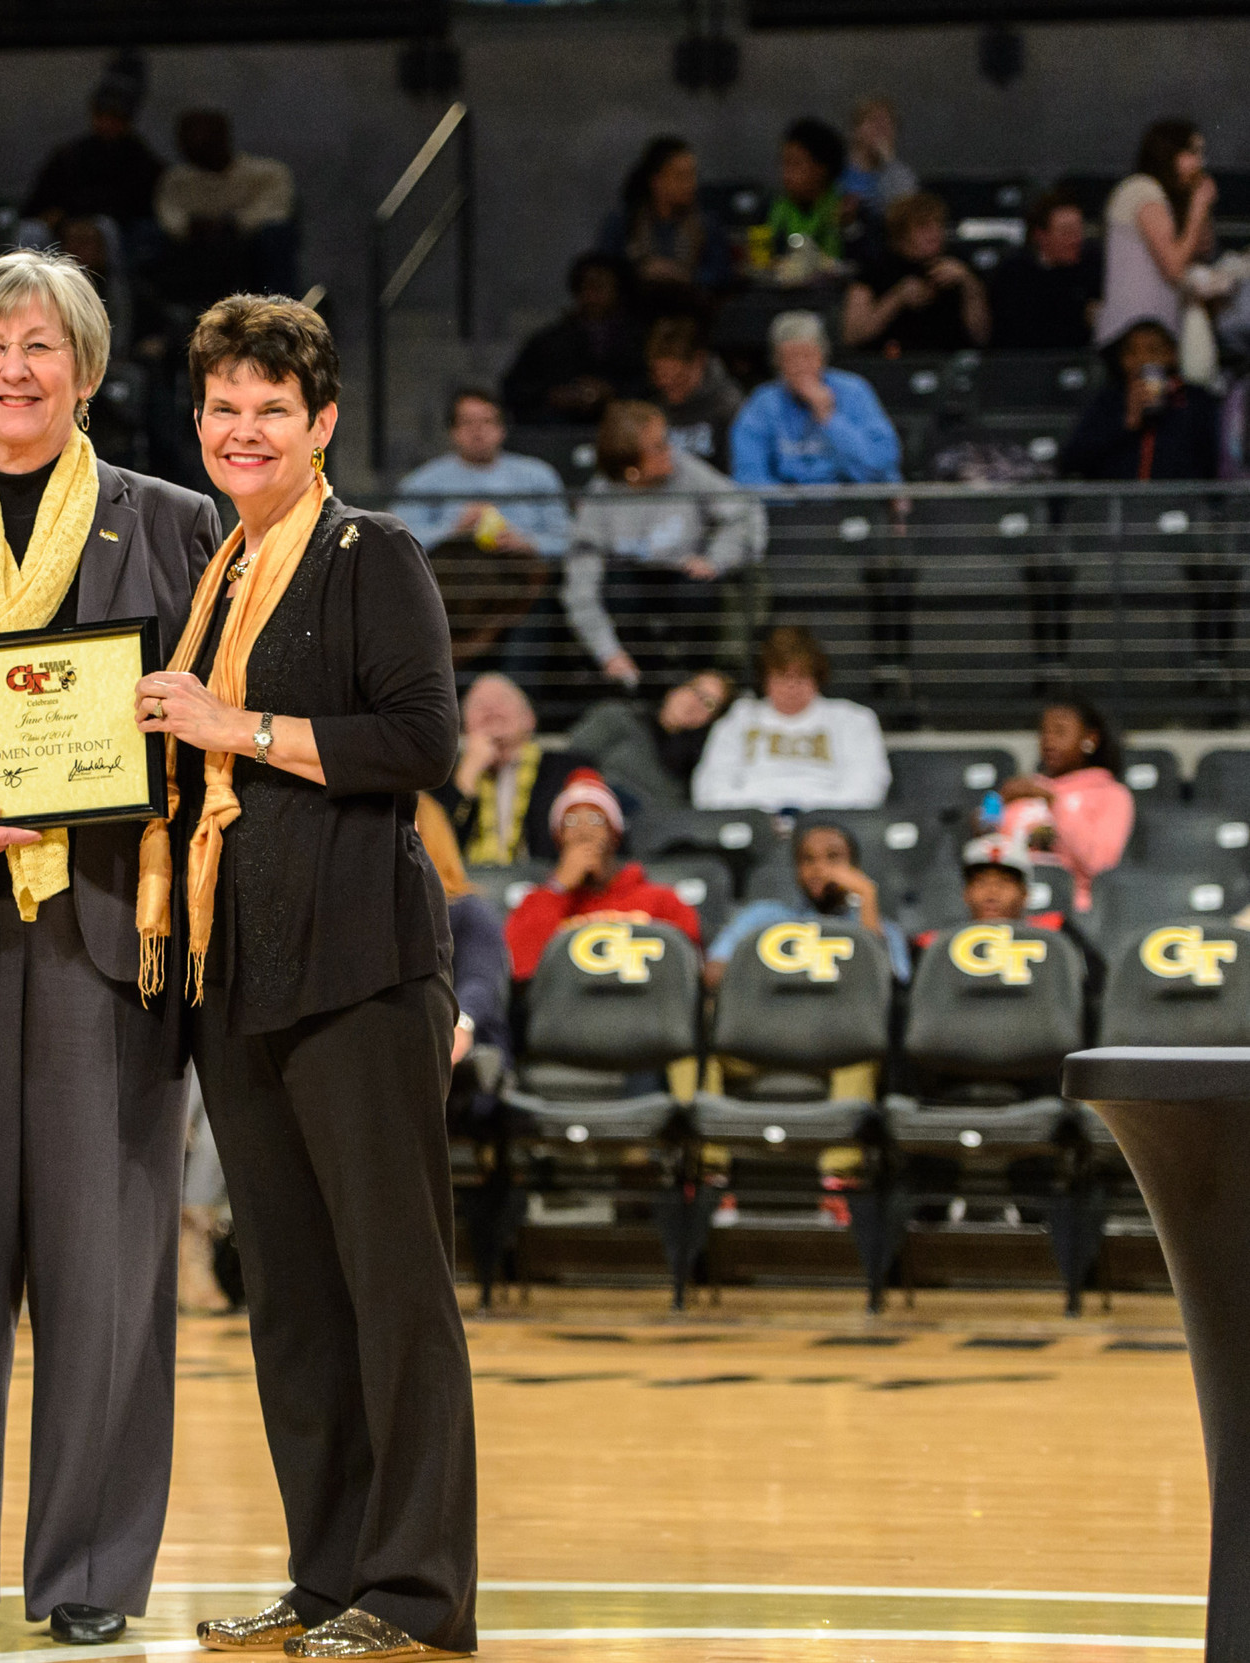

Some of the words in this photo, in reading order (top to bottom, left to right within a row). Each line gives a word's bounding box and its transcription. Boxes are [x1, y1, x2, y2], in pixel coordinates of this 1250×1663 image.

[6, 664, 51, 693] GT
[27, 699, 59, 707] Celebrates
[15, 710, 43, 728] Jane
[45, 708, 79, 724] Stoner
[21, 732, 40, 742] Class
[40, 733, 48, 743] of
[48, 729, 73, 740] 2014
[35, 744, 64, 757] OUT
[68, 739, 113, 753] FRONT
[569, 922, 665, 983] GT
[757, 922, 854, 982] GT
[949, 924, 1047, 985] GT
[1140, 926, 1237, 986] GT
